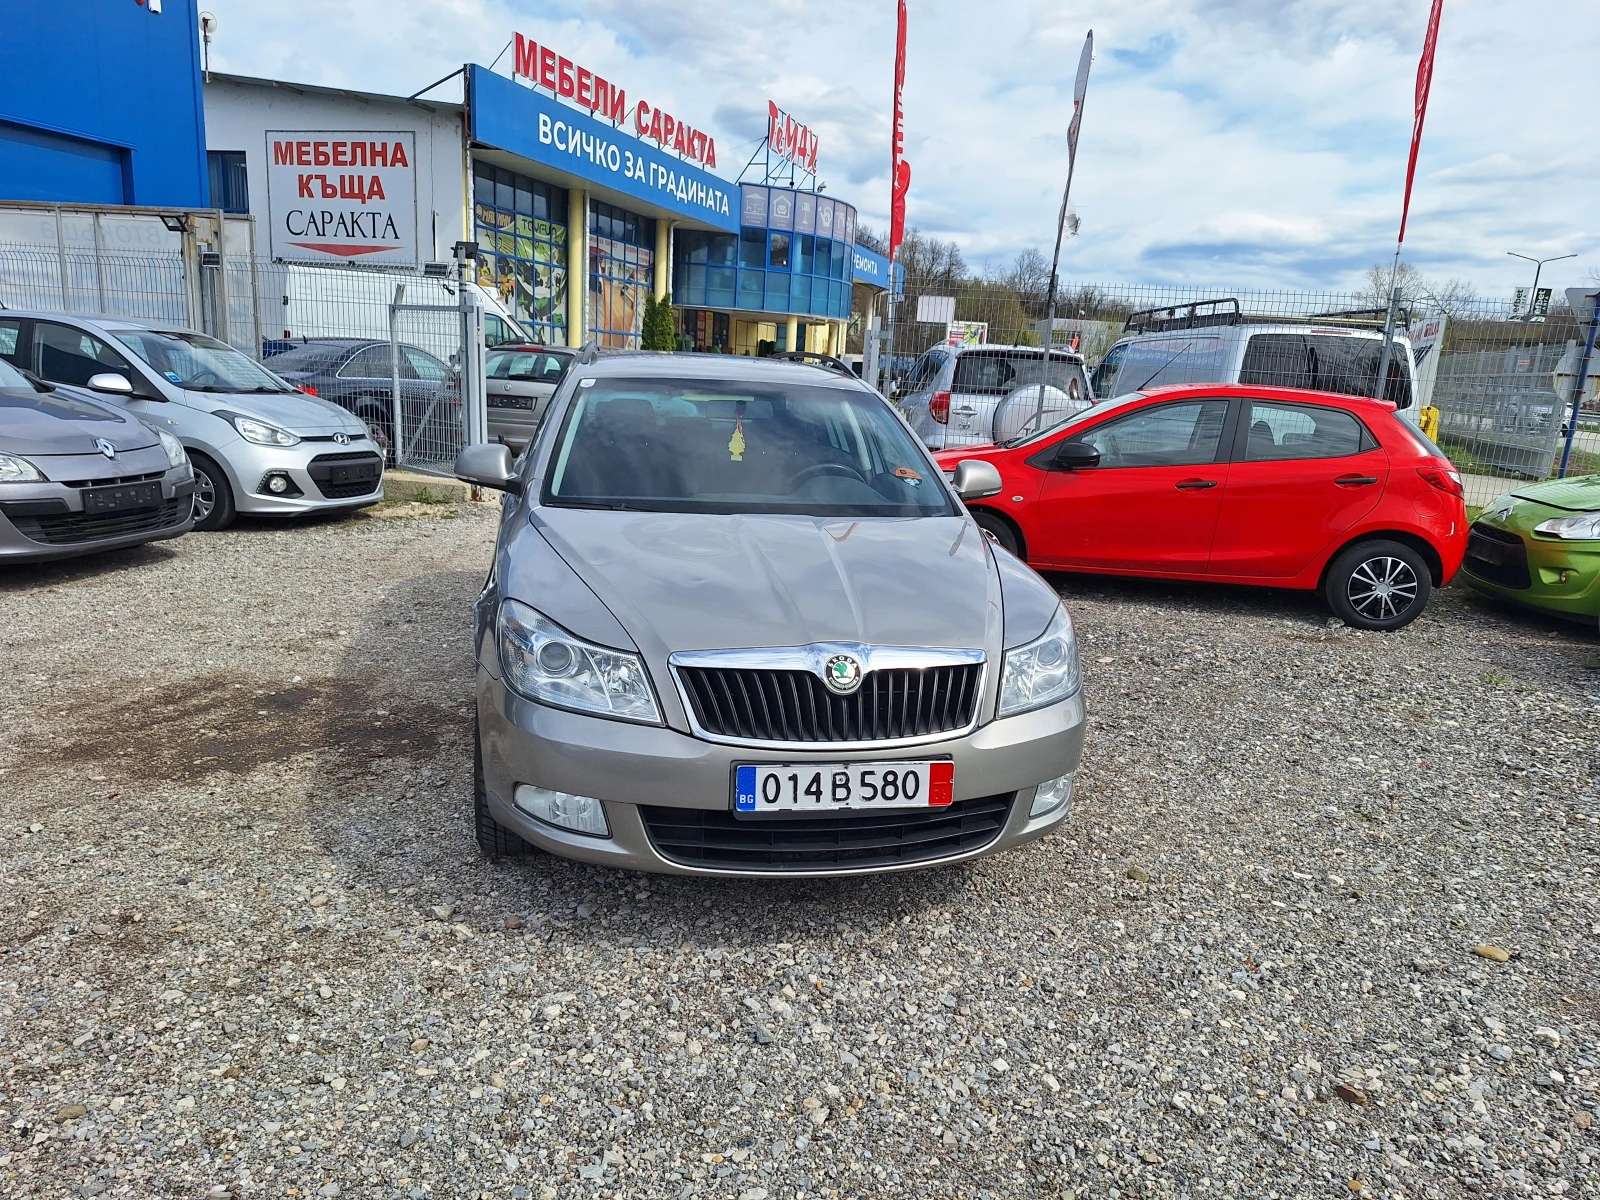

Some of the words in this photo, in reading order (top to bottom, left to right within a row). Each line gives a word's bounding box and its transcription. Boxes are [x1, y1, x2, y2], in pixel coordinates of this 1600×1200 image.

[512, 31, 625, 125] МЕБЕЛИ
[634, 100, 717, 168] САРАКТА
[273, 141, 409, 168] МЕБЕЛНА
[538, 112, 621, 172] ВСИЧКО
[624, 150, 646, 183] ЗА
[649, 161, 730, 216] ГРАДИНАТА
[297, 173, 386, 204] КЪЩА
[285, 210, 400, 240] САРАКТА
[739, 794, 754, 804] BG
